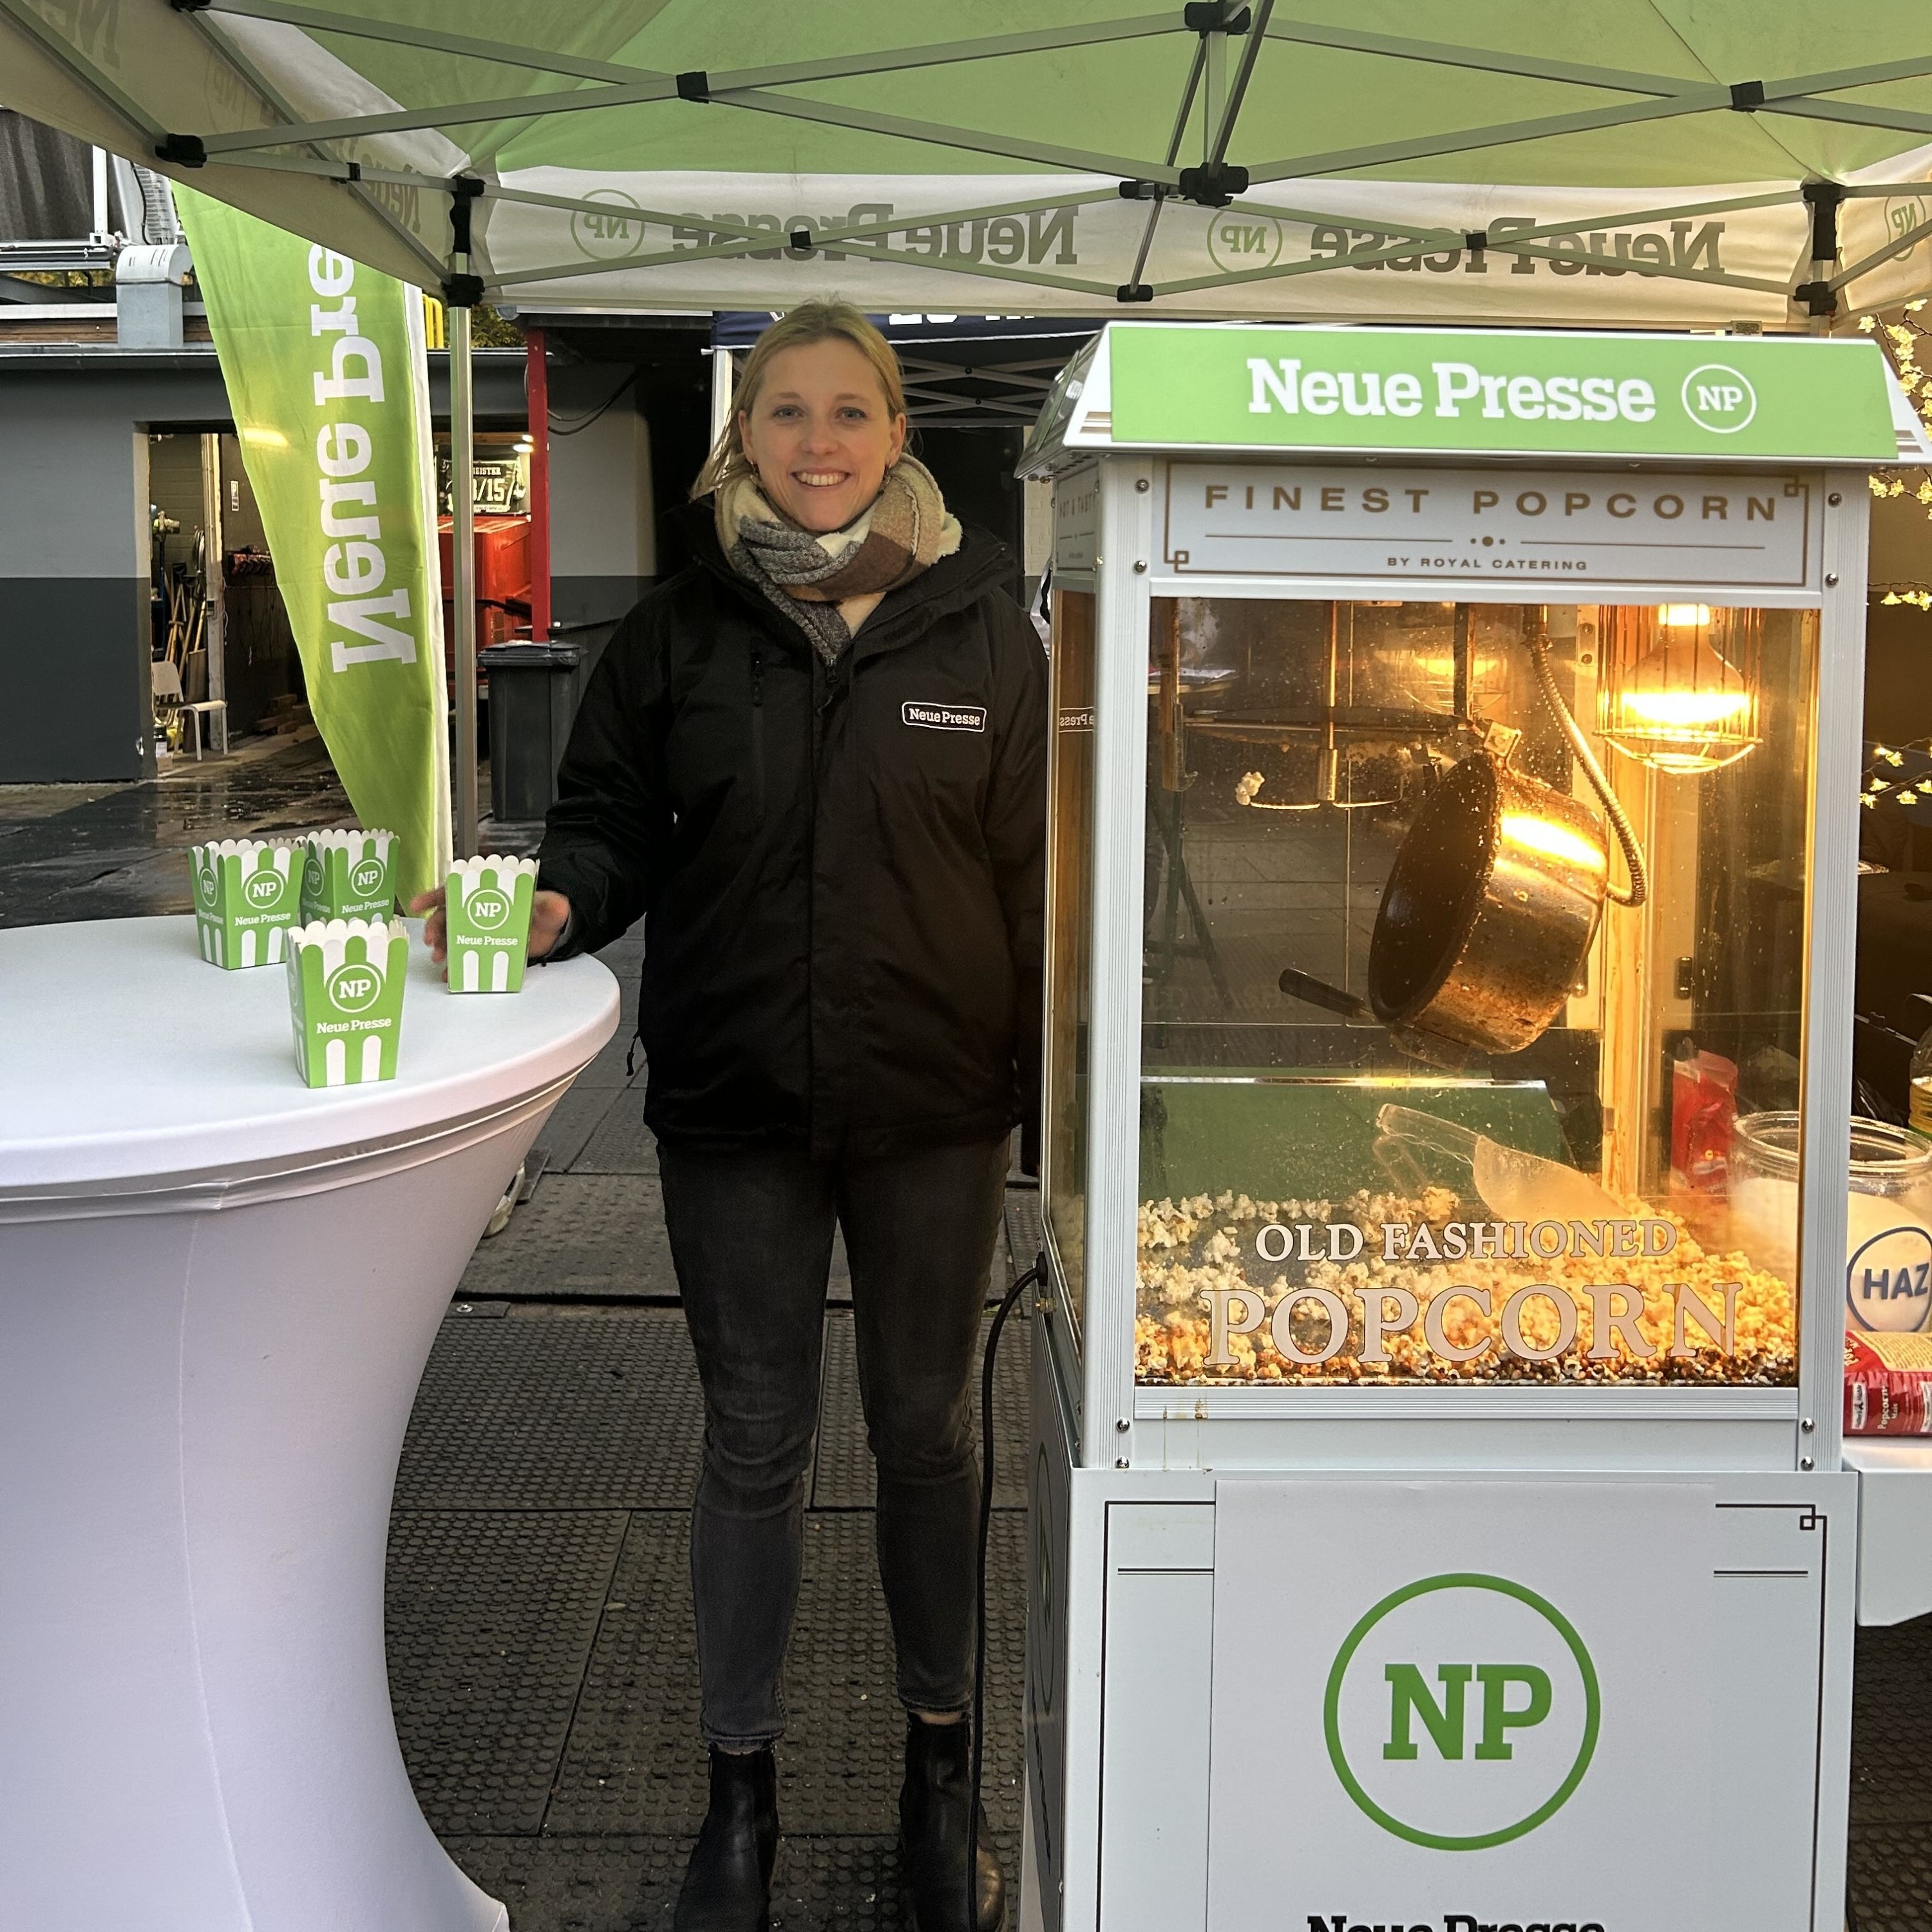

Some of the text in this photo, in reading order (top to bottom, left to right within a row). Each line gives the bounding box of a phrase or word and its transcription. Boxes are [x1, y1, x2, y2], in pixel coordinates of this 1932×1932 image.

[1247, 357, 1743, 422] Neue Presse NP
[1204, 484, 1777, 521] FINEST POPCORN
[1387, 556, 1587, 571] BY ROYAL CATERING
[909, 708, 980, 726] Neue Presse
[308, 869, 320, 883] NP
[357, 870, 378, 886] NP
[202, 879, 214, 895] NP
[252, 882, 277, 898] NP
[342, 898, 390, 914] Neue Presse
[475, 902, 502, 917] NP
[235, 913, 290, 926] Neue Presse
[457, 935, 518, 946] Neue Presse
[339, 979, 372, 999] NP
[317, 1018, 392, 1034] Neue Presse
[1256, 1220, 1678, 1262] OLD FASHIONED
[1863, 1262, 1929, 1300] HAZ
[1200, 1282, 1743, 1365] POPCORN
[1383, 1663, 1553, 1761] NP
